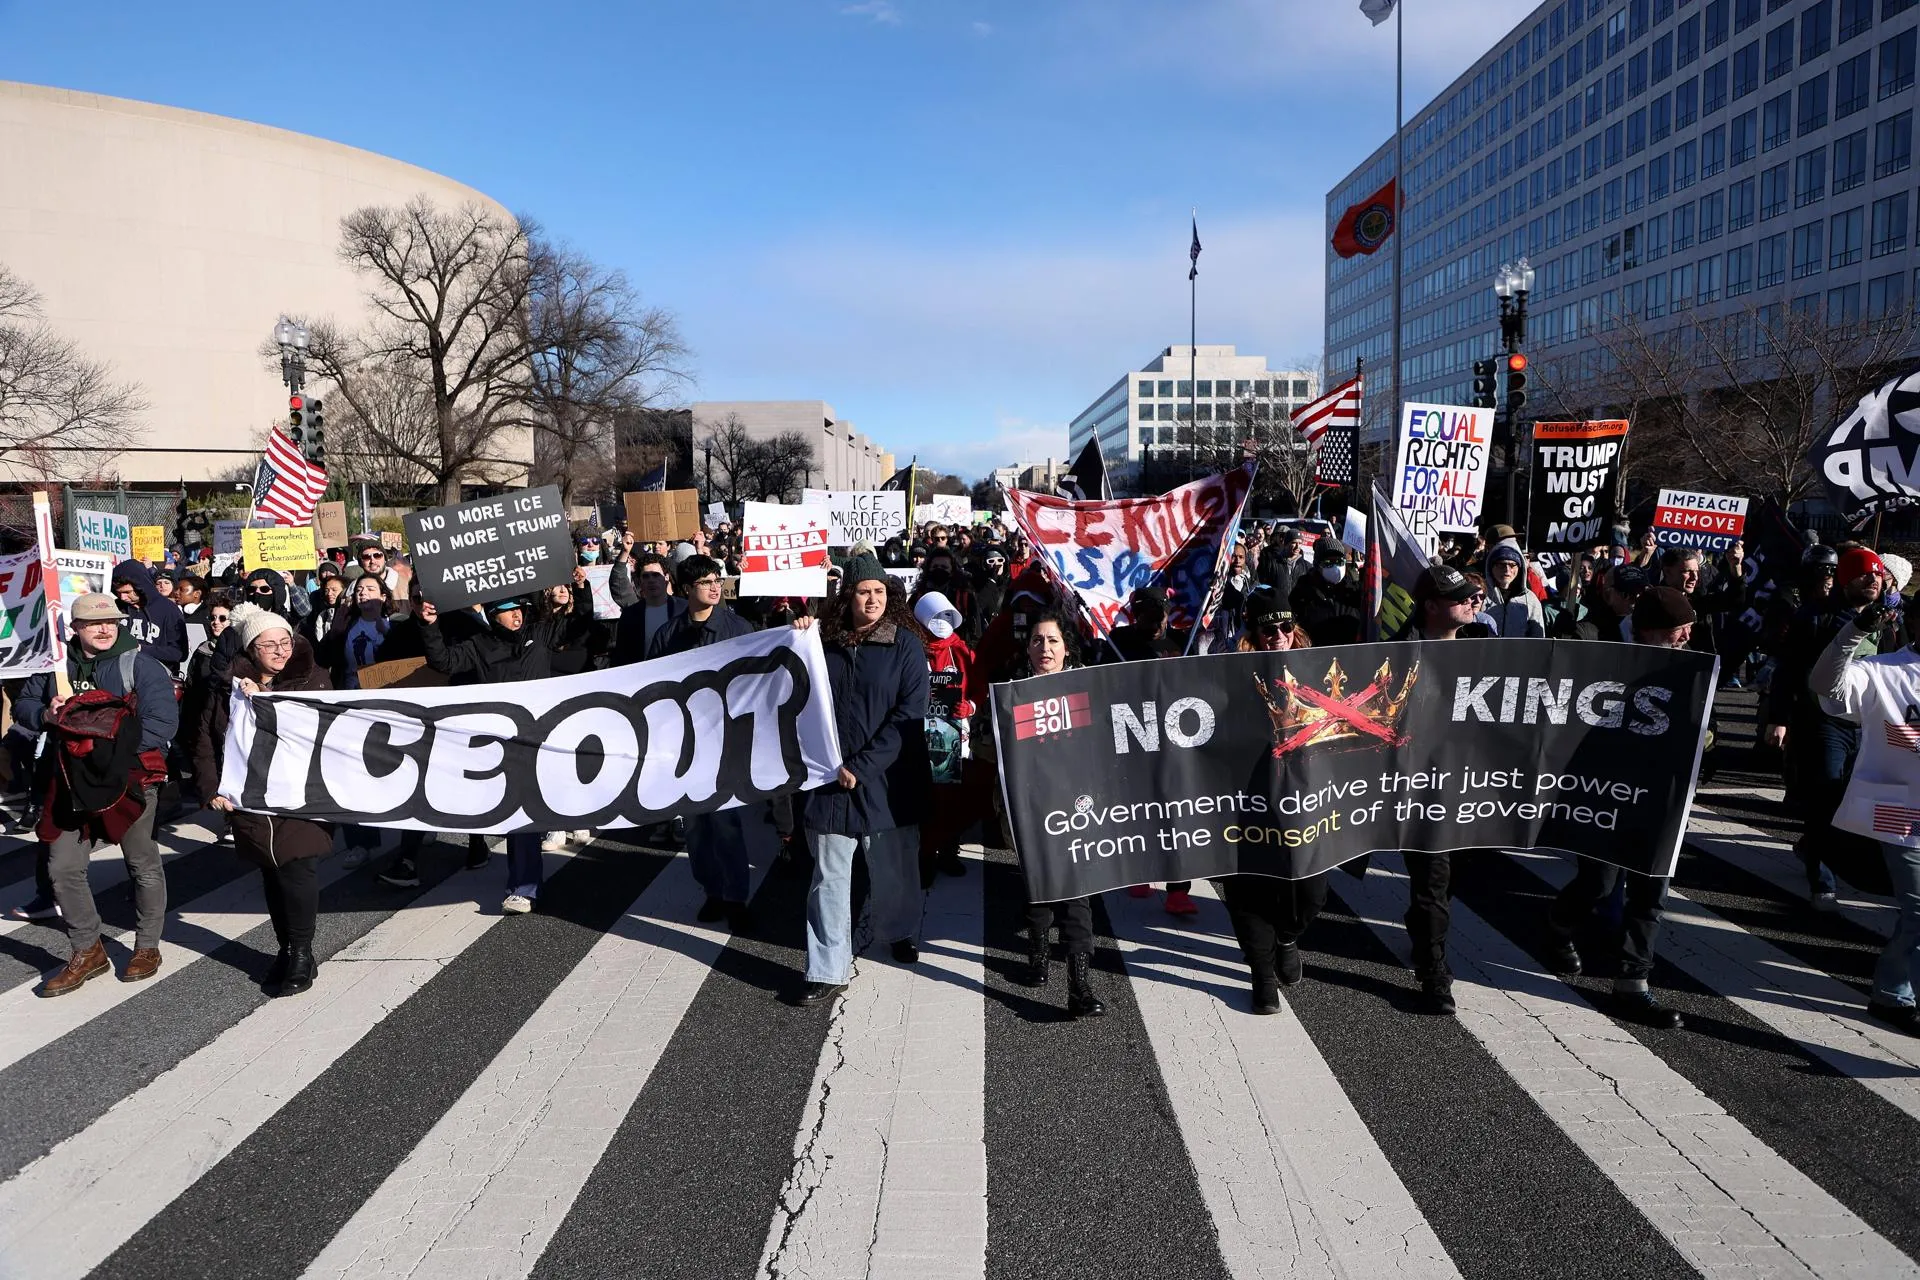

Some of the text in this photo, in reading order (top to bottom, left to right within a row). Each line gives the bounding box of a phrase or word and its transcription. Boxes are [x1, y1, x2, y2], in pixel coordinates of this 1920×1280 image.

[1409, 409, 1484, 443] EQUAL
[1406, 438, 1483, 471] RIGHTS
[1539, 442, 1617, 468] TRUMP
[1402, 466, 1477, 498] FOR ALL
[1546, 468, 1608, 493] MUST
[420, 495, 543, 532] NO MORE ICE
[852, 495, 885, 511] ICE
[1563, 495, 1595, 519] GO
[1666, 493, 1740, 513] IMPEACH
[79, 516, 128, 539] WE HAD
[830, 511, 902, 527] MURDERS
[1546, 517, 1603, 543] NOW!
[1662, 510, 1736, 531] REMOVE
[82, 536, 127, 555] WHISTLES
[415, 514, 562, 556] NO MORE TRUMP
[751, 531, 824, 550] FUERA
[843, 527, 888, 542] MOMS
[1656, 530, 1733, 550] CONVICT
[56, 557, 105, 569] CRUSH
[442, 545, 549, 583] ARREST THE
[767, 552, 803, 571] ICE
[465, 566, 537, 594] RACISTS
[1110, 676, 1673, 755] NO KINGS
[252, 652, 804, 823] ICE OUT
[1044, 790, 1268, 836] Governments
[1279, 778, 1368, 816] derive
[1379, 766, 1451, 793] their
[1460, 765, 1523, 794] just
[1536, 772, 1648, 804] power
[1068, 798, 1619, 864] from the consent of the governed
